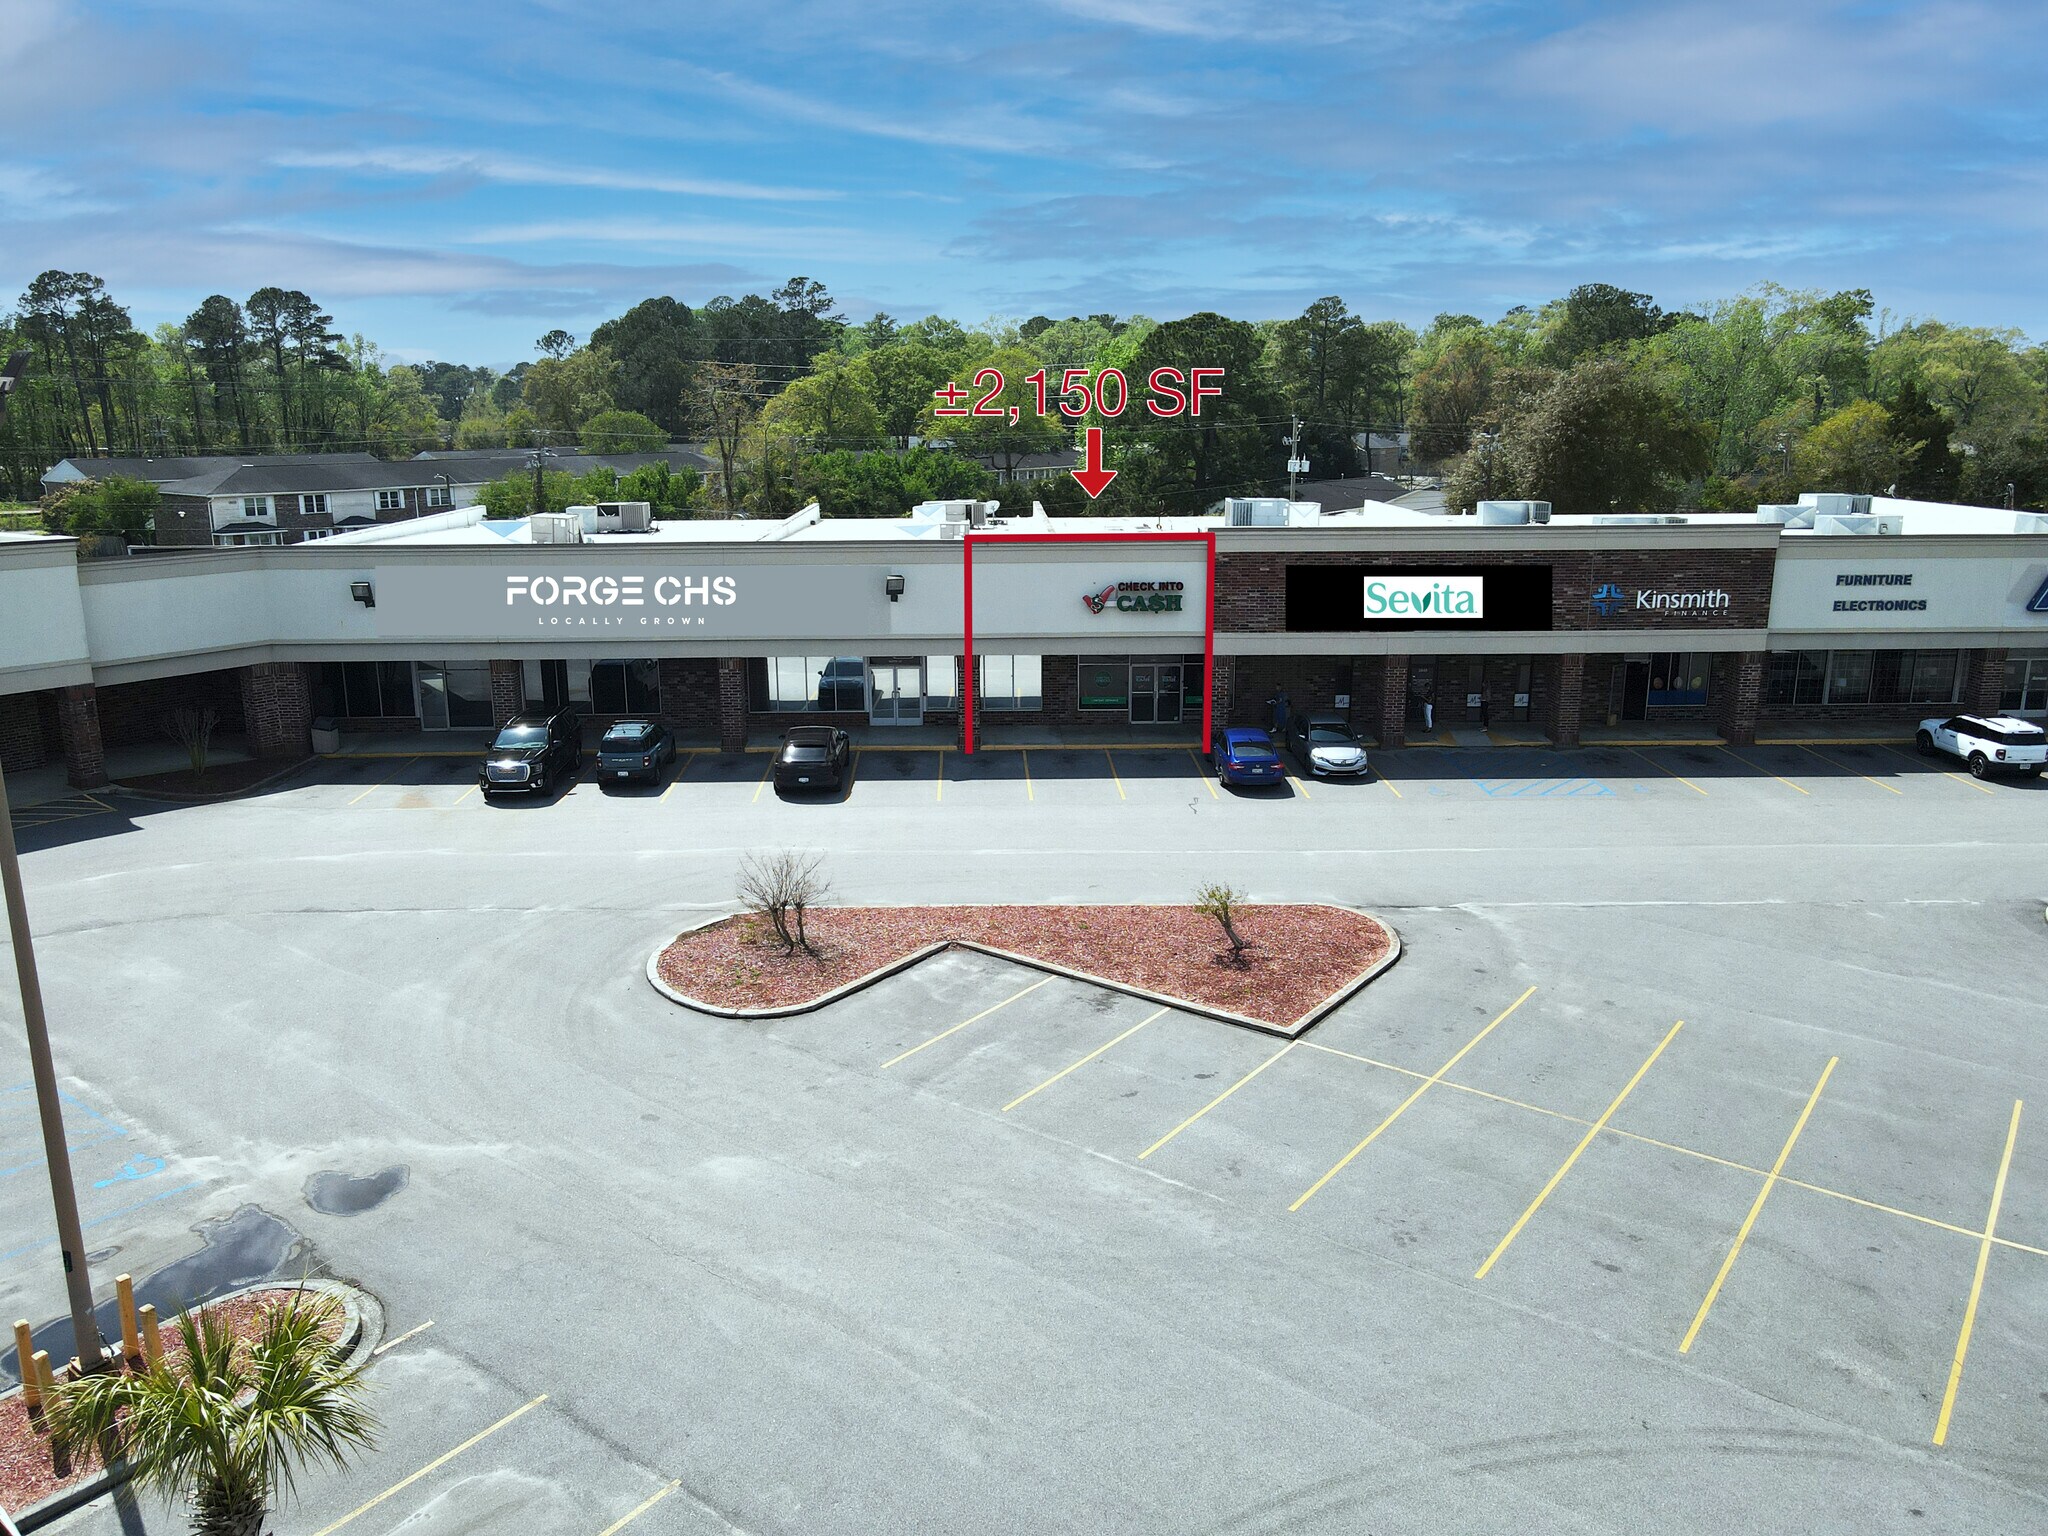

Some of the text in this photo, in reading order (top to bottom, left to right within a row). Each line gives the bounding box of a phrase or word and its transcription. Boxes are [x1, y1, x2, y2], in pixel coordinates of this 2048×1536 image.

[1835, 574, 1913, 586] FURNITURE
[506, 576, 737, 606] FORGE CHS
[1117, 581, 1184, 592] CHECK INTO
[1366, 582, 1475, 614] Sevita
[1636, 588, 1730, 609] Kinsmith
[1832, 600, 1928, 612] ELECTRONICS
[1664, 609, 1728, 617] FINANCE
[538, 617, 705, 625] LOCALLY GROWN
